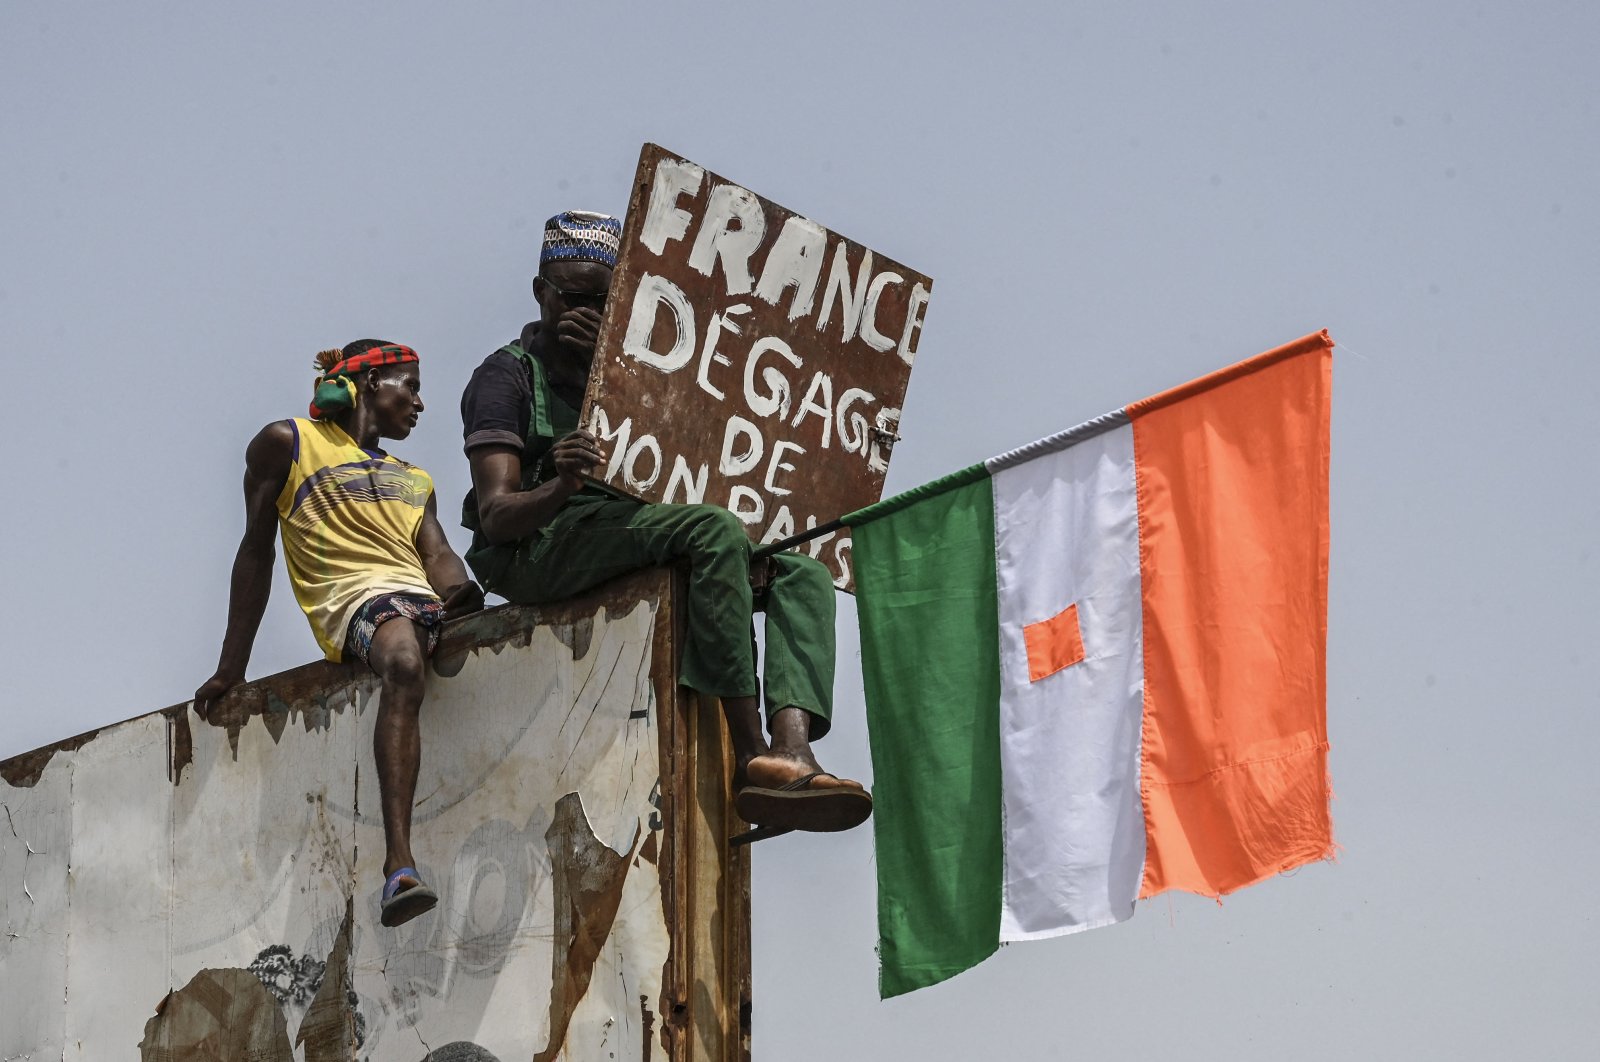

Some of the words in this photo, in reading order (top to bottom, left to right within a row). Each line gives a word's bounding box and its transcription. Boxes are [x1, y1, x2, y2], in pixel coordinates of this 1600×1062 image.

[640, 157, 932, 367] FRANCE
[588, 404, 709, 505] MON
[719, 415, 808, 496] DE
